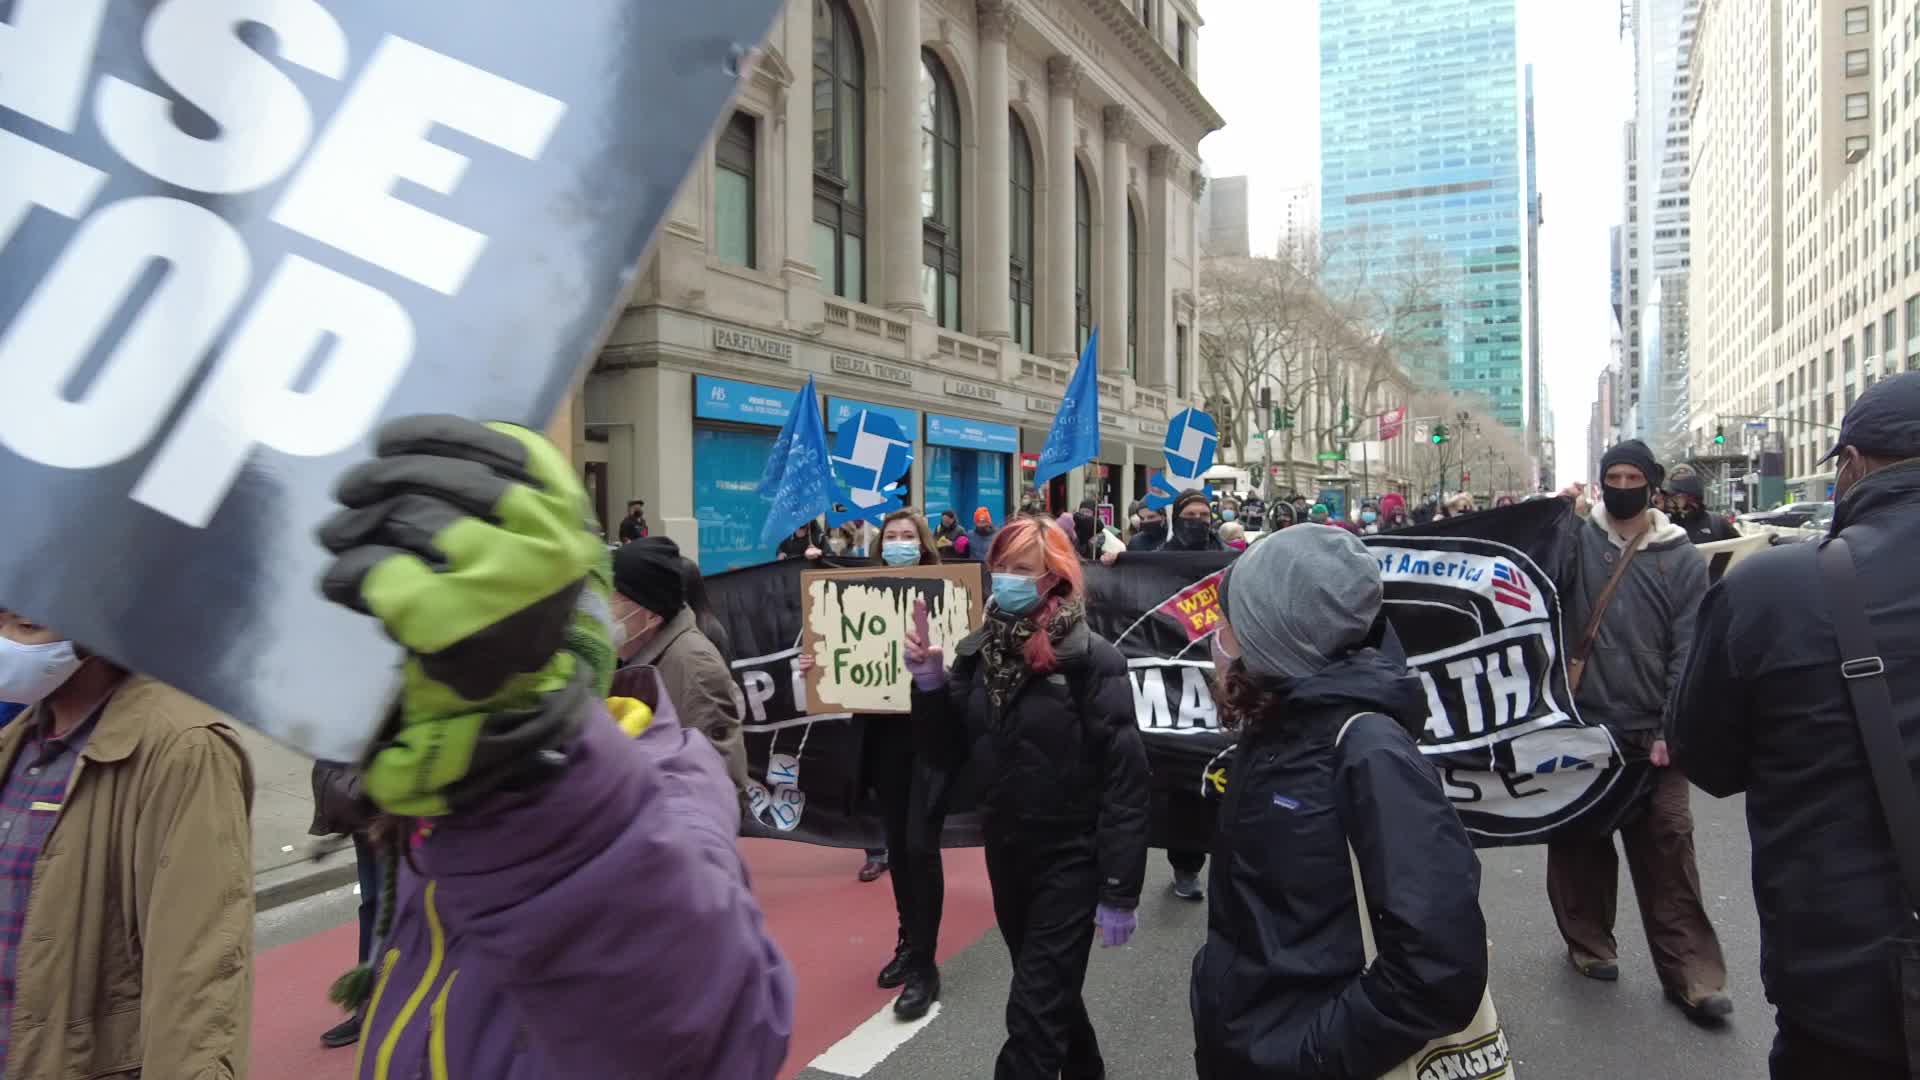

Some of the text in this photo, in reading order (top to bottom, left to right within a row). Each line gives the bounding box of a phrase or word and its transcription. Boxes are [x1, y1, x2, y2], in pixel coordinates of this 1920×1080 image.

[717, 329, 793, 360] PARFUMERIE
[1397, 554, 1484, 582] America
[1189, 604, 1219, 630] FA
[833, 640, 898, 687] Fossil
